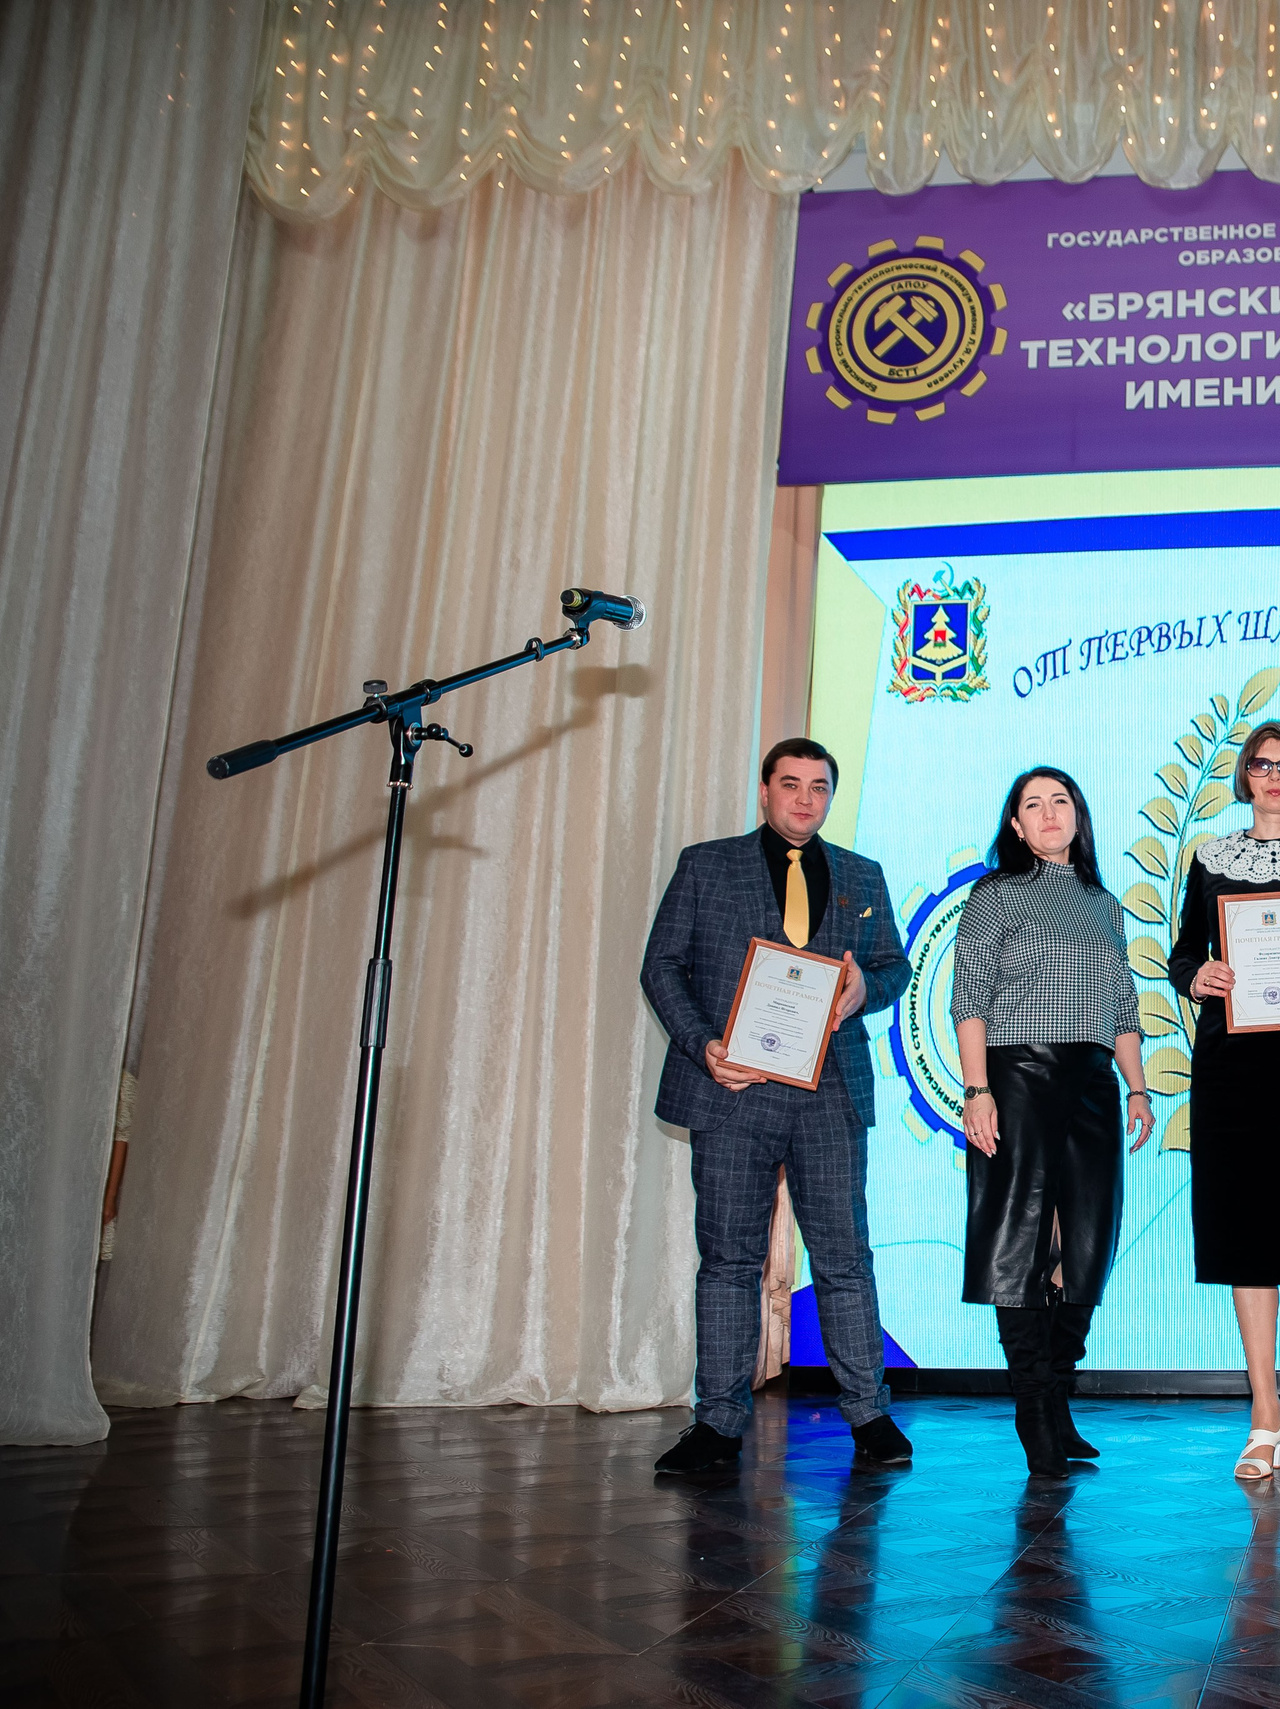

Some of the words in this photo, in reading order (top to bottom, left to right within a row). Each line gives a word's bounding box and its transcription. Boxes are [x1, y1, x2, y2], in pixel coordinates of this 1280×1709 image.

[1047, 223, 1276, 248] ГОСУДАРСТВЕННОЕ
[890, 280, 929, 292] ГАПОУ
[888, 366, 919, 377] БСТТ
[1013, 638, 1072, 698] ОТ
[1079, 610, 1232, 671] ПЕРВЫХ
[1235, 936, 1273, 944] ПОЧЕТНАЯ
[754, 980, 791, 996] ПОЧЕТНАЯ
[790, 989, 824, 1004] ГРАМОТА
